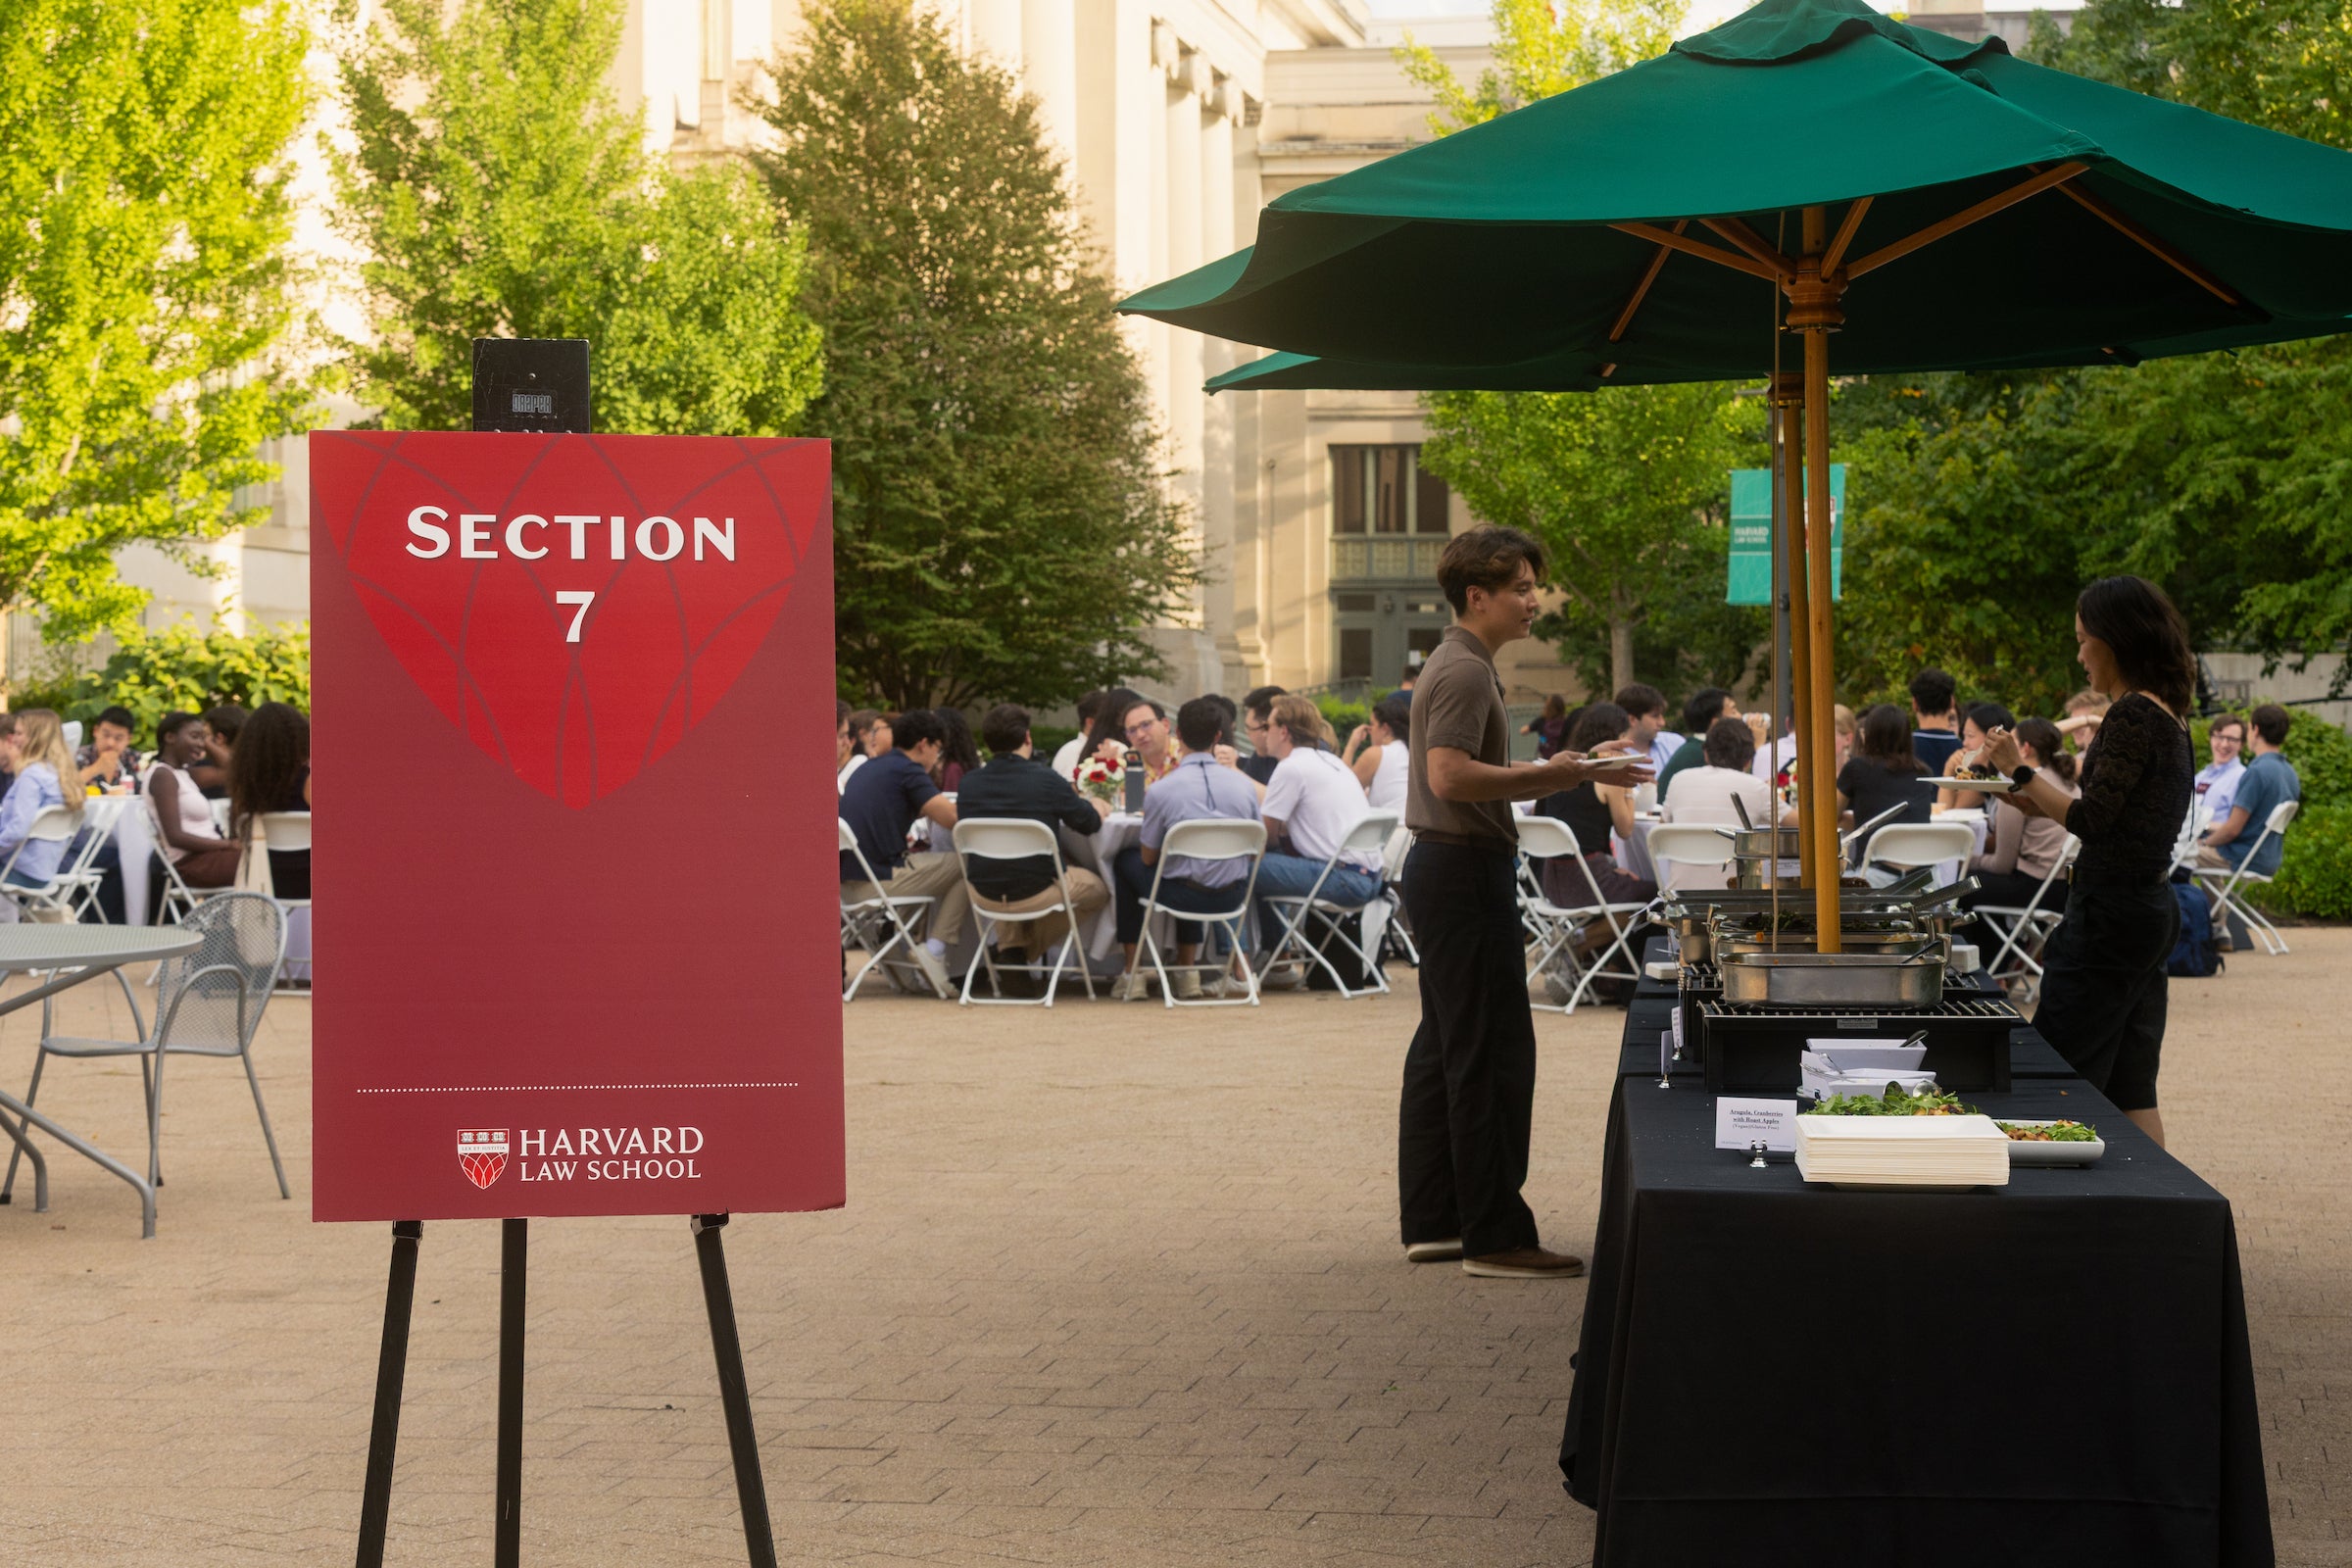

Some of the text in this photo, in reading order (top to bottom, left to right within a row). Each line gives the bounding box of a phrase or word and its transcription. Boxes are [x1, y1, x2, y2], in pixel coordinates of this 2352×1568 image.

[405, 505, 735, 562] SECTION
[556, 591, 596, 643] 7
[519, 1127, 705, 1156] HARVARD
[520, 1158, 702, 1182] LAW SCHOOL
